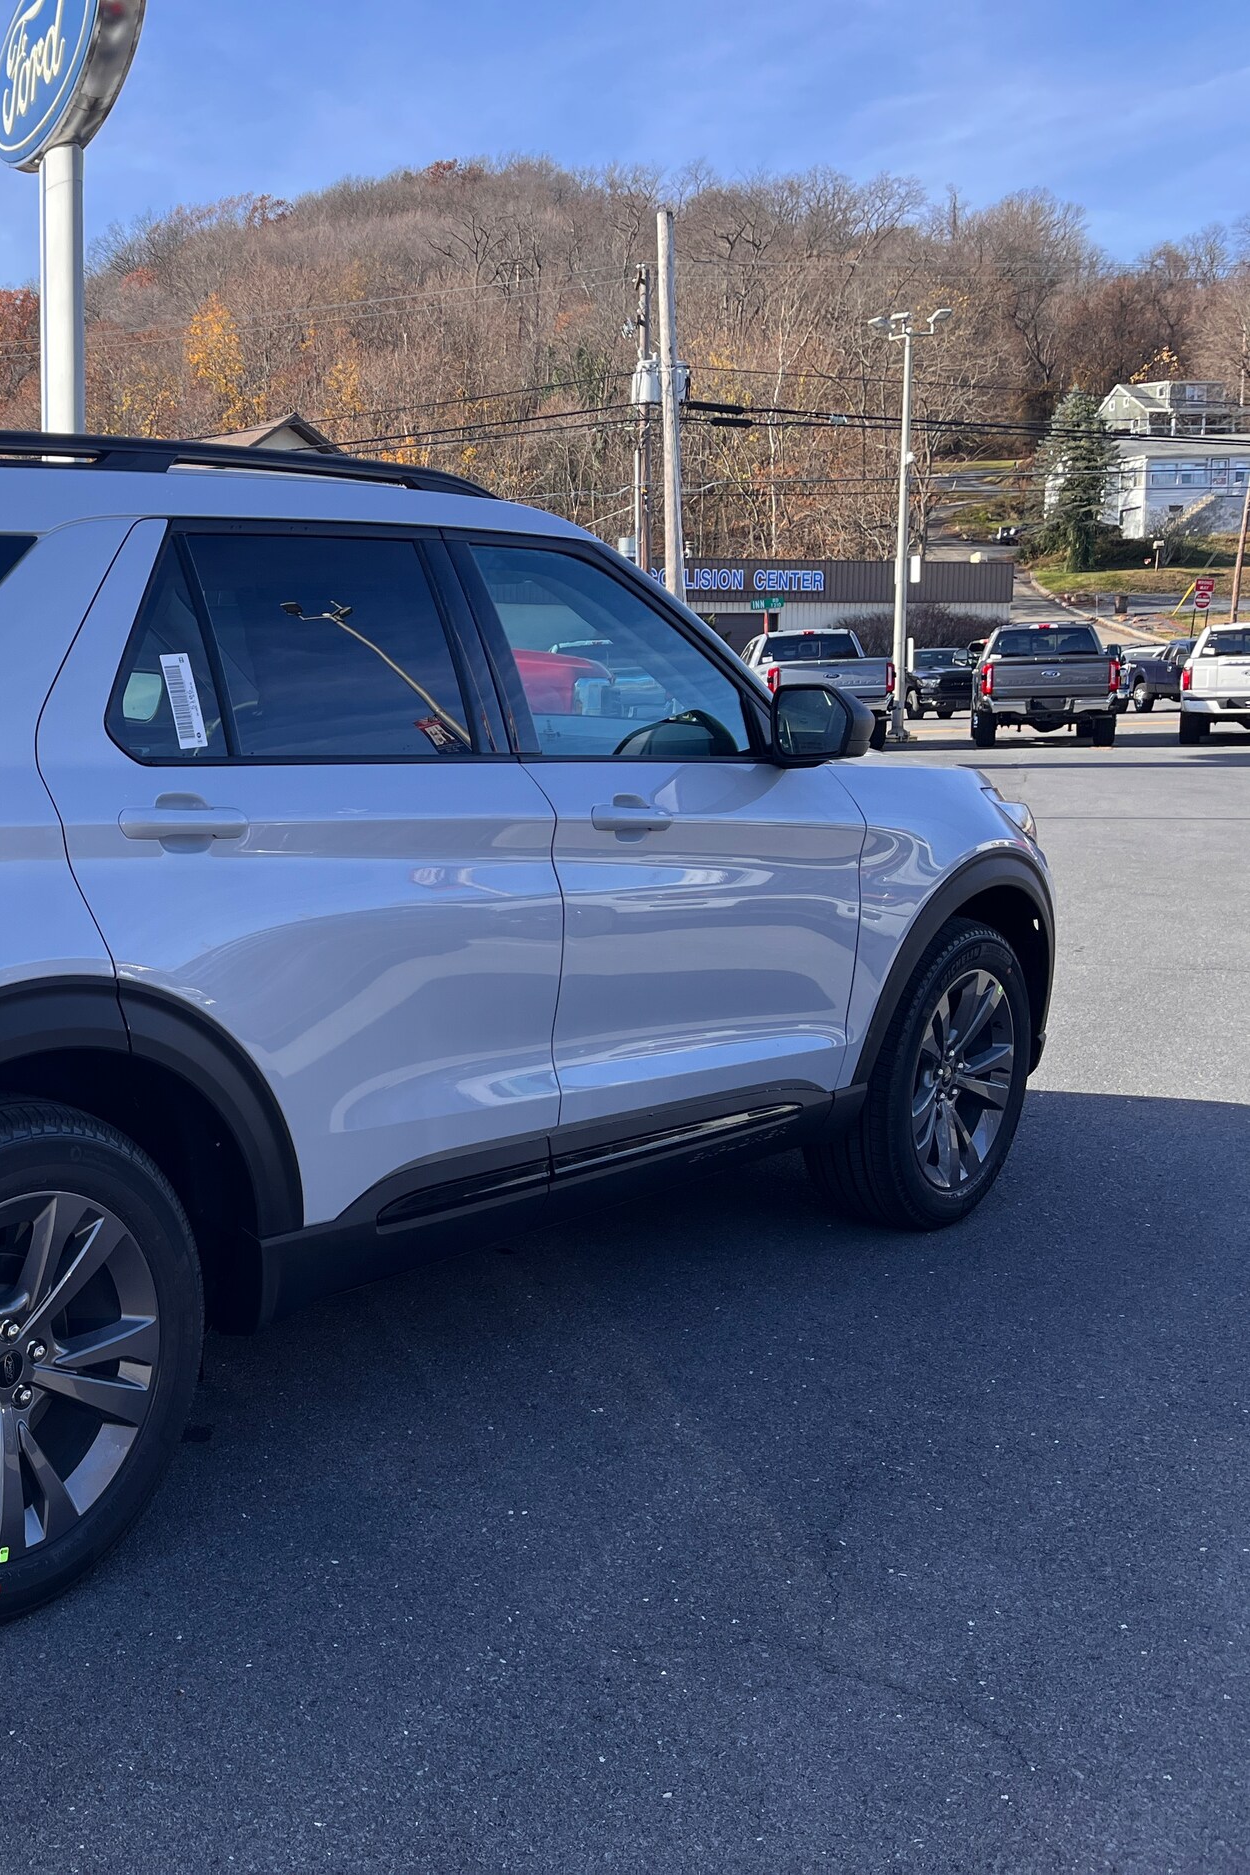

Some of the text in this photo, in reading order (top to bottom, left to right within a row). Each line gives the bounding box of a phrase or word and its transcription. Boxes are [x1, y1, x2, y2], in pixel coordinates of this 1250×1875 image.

[2, 0, 65, 135] Ford
[753, 569, 825, 591] CENTER
[752, 600, 765, 609] INN
